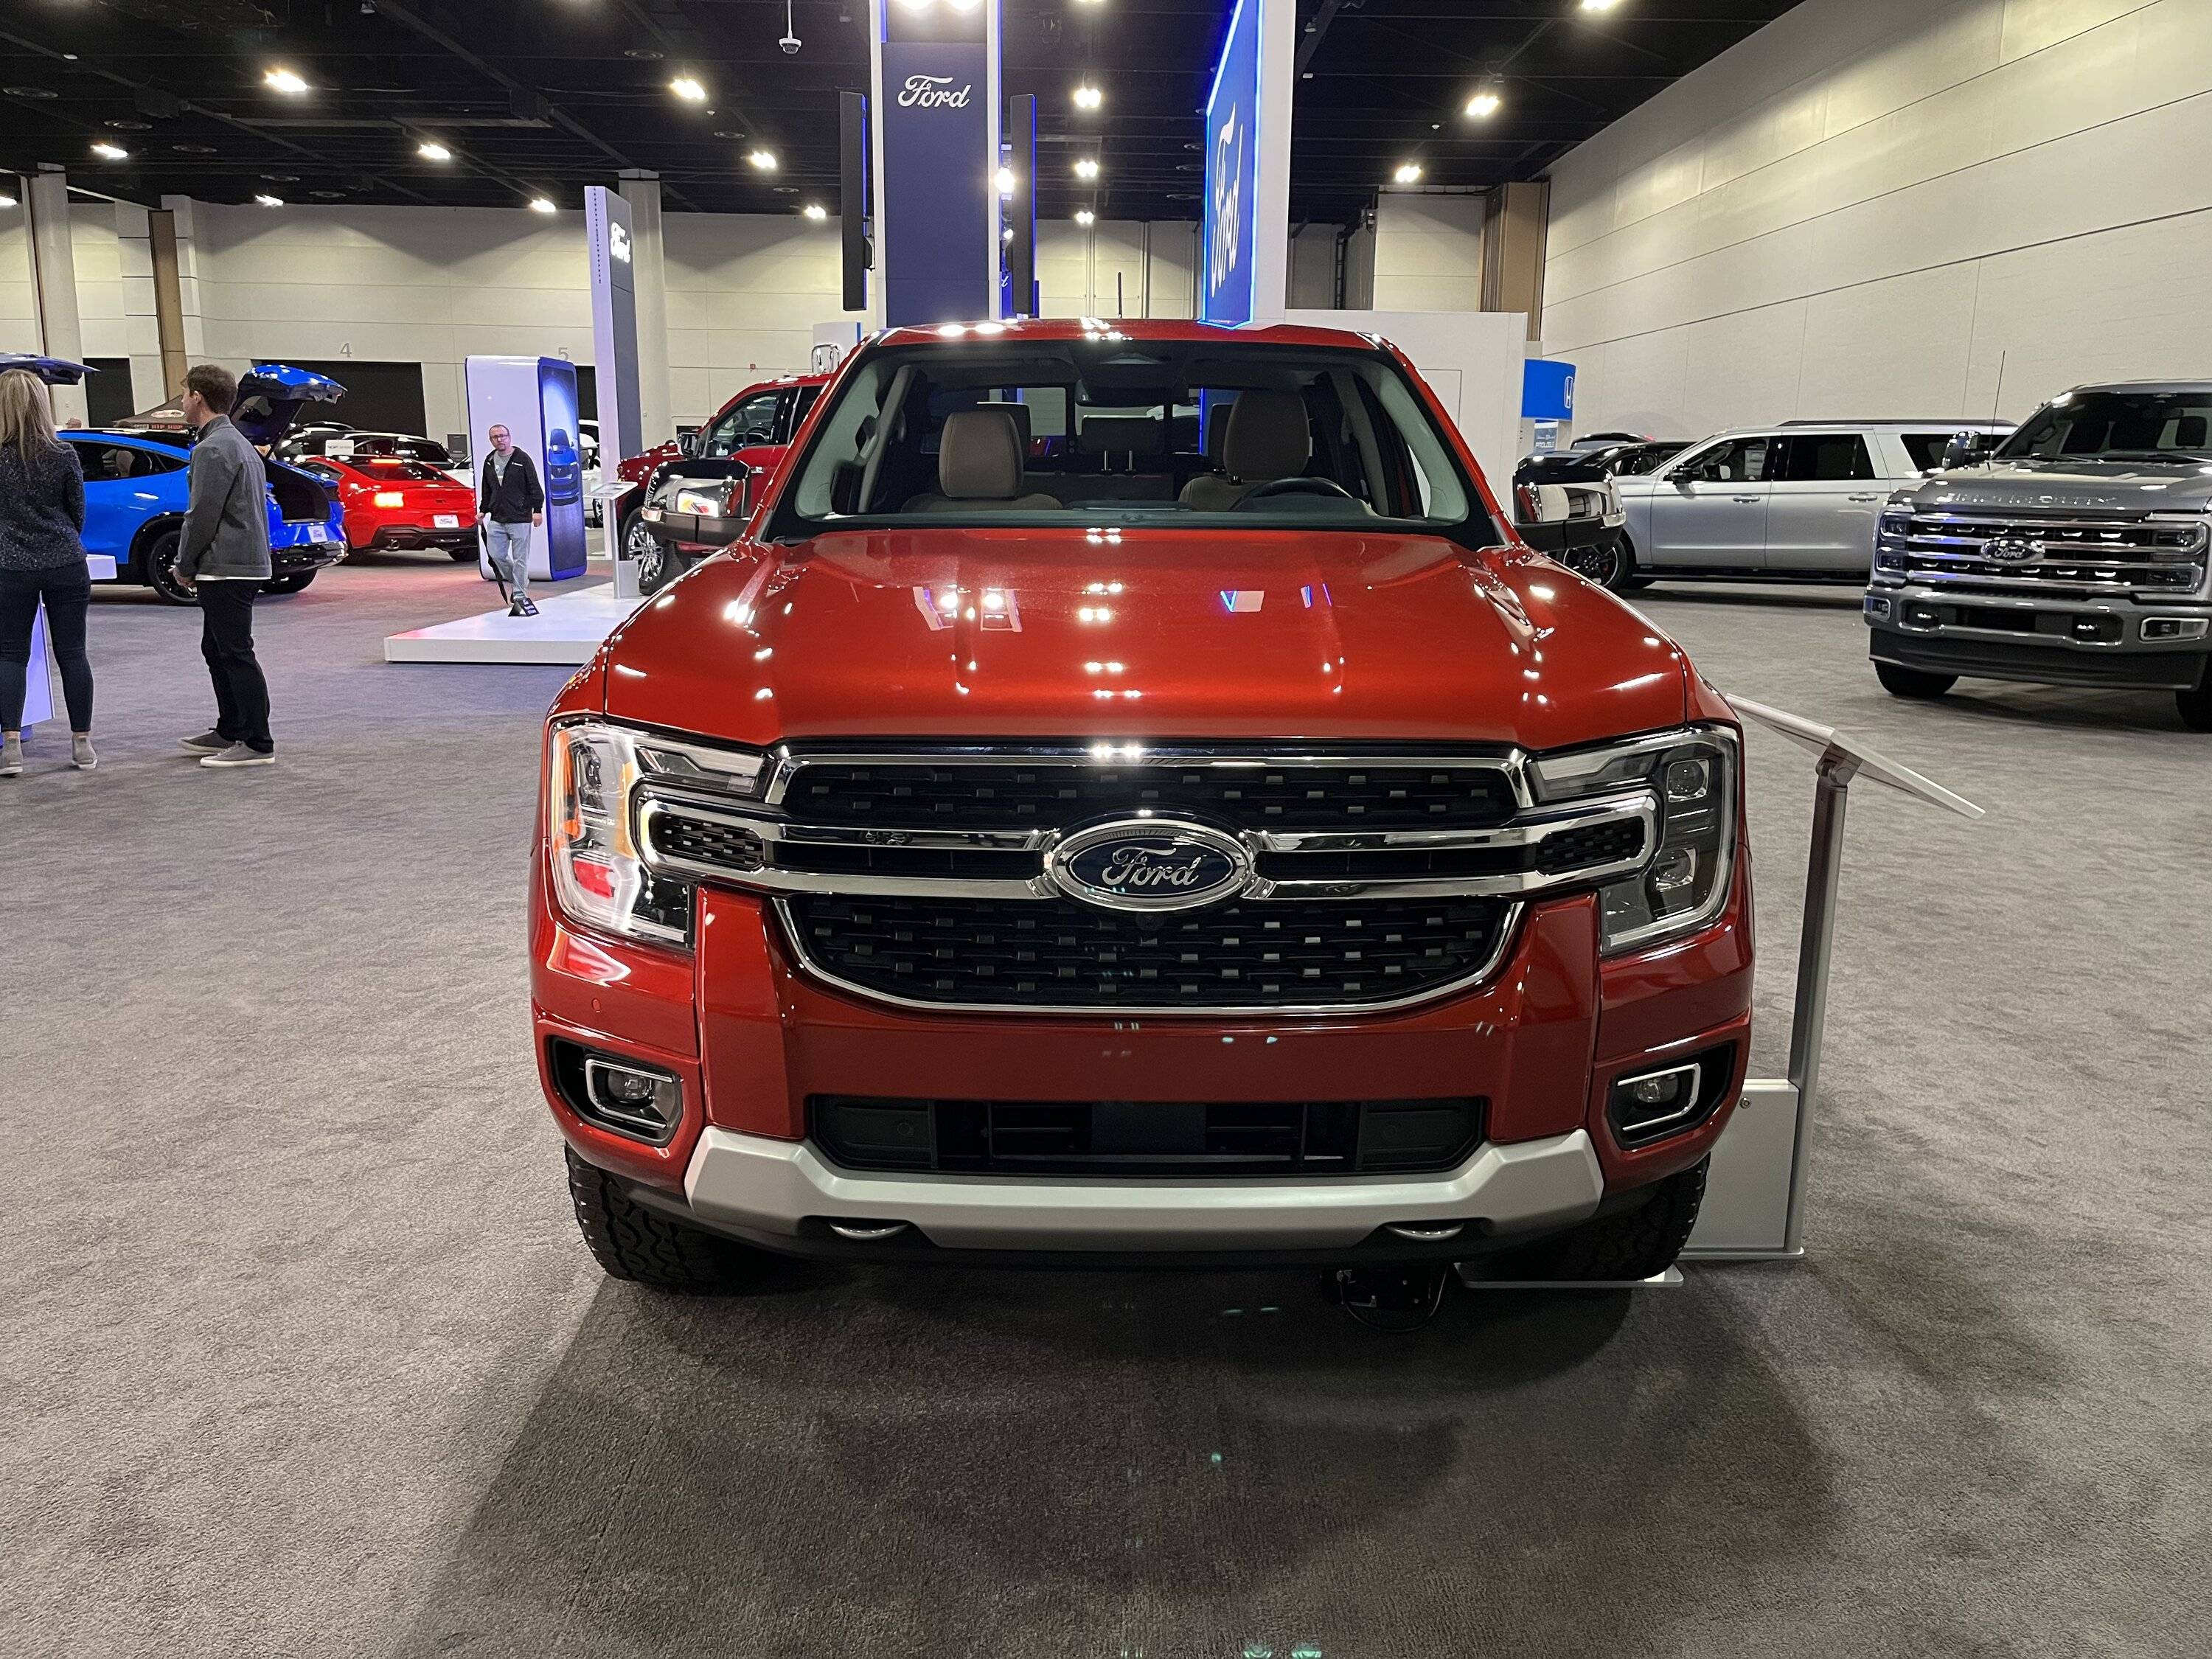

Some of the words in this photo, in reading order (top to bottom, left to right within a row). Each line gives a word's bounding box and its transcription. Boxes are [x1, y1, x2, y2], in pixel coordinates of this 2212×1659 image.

[897, 74, 972, 108] Ford
[1211, 101, 1243, 299] Ford
[340, 342, 352, 358] 4
[1994, 546, 2025, 558] Ford
[1102, 846, 1201, 886] Ford
